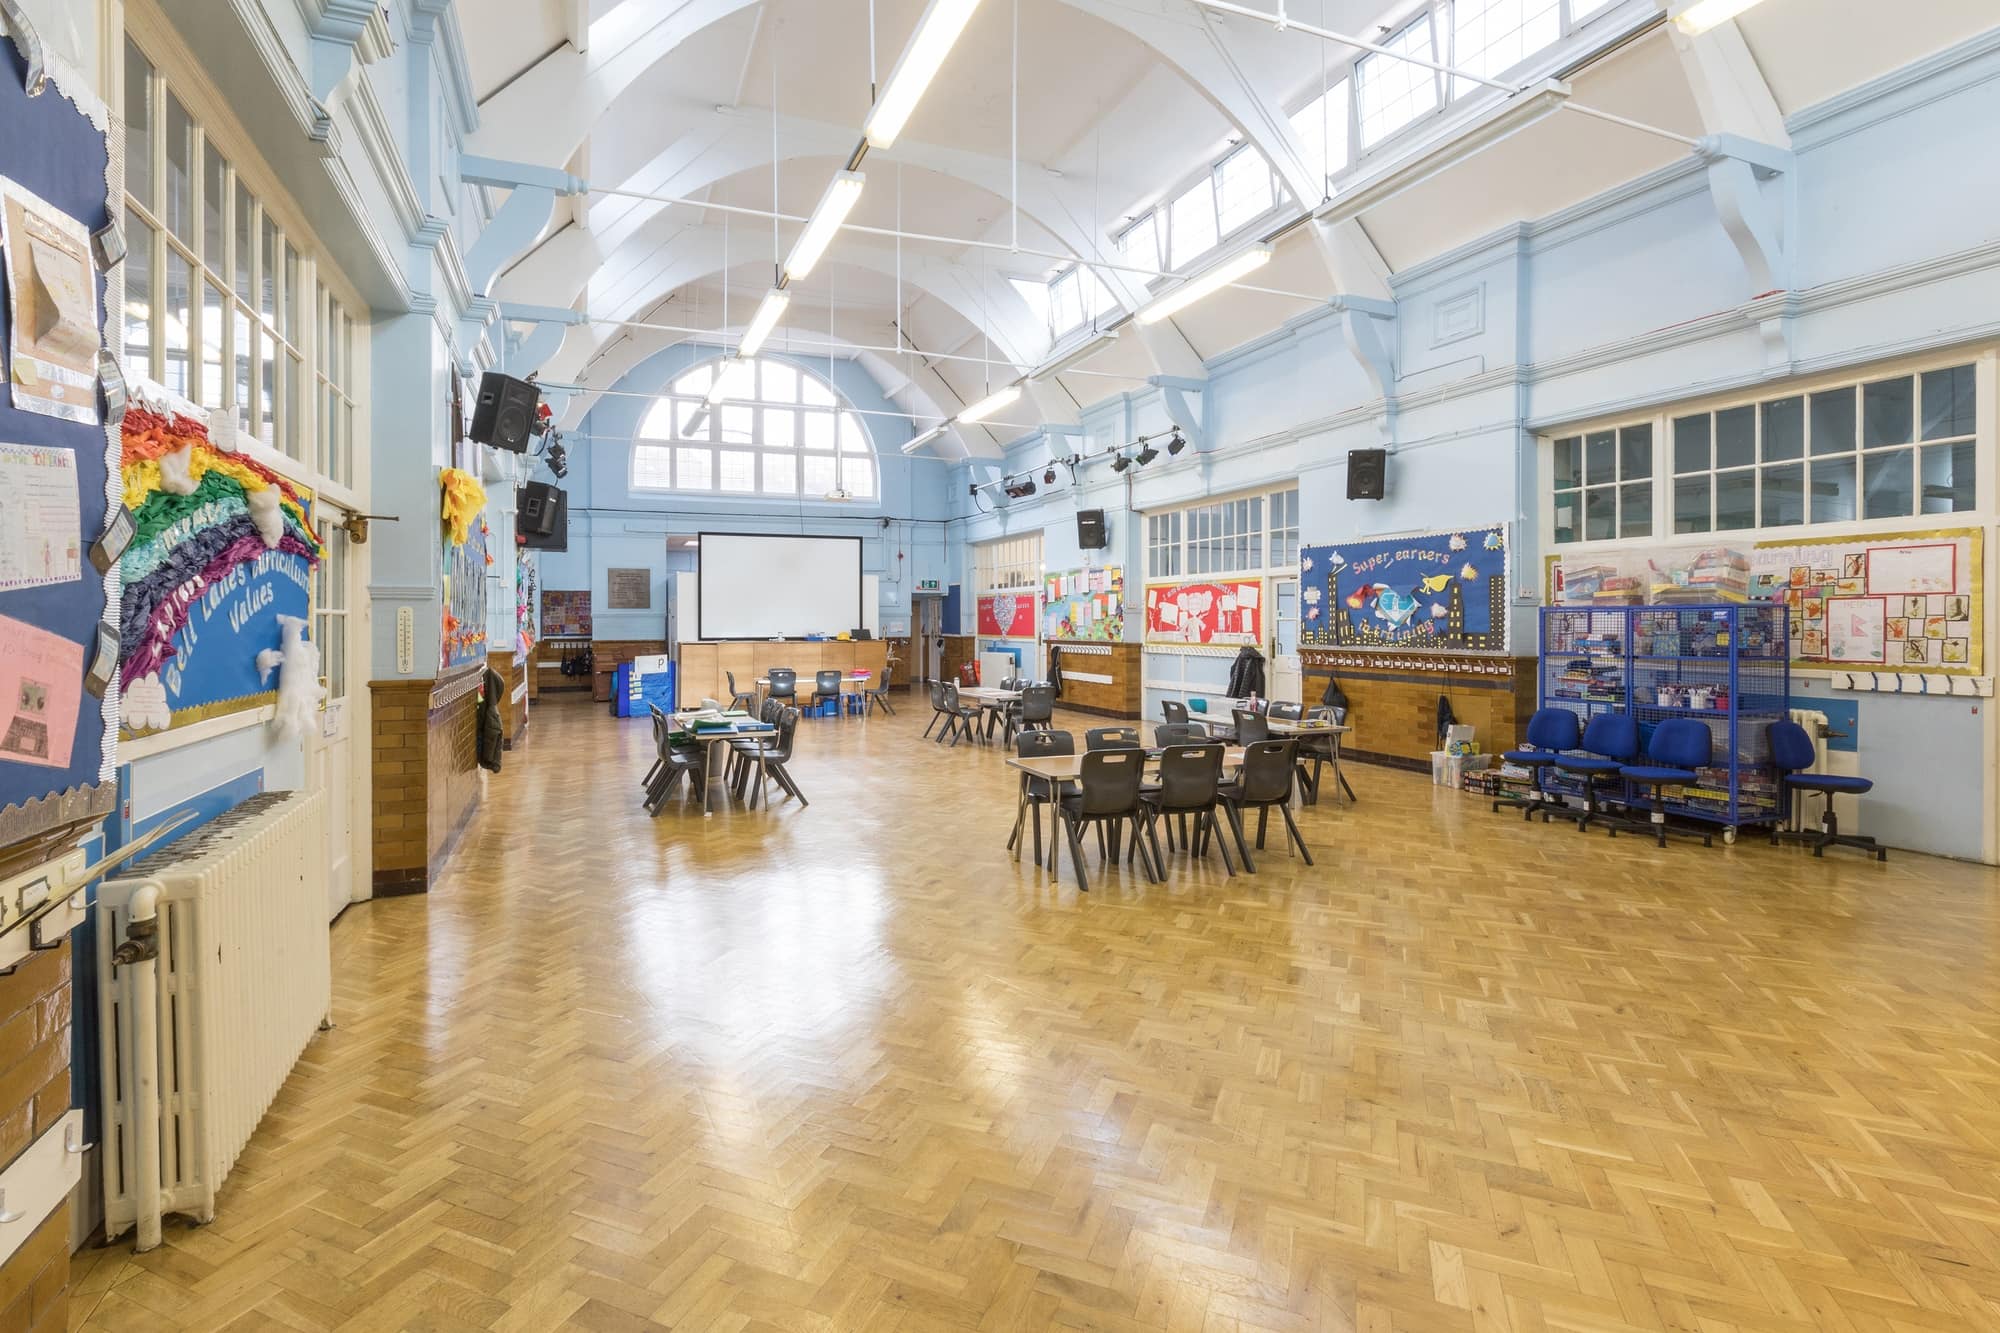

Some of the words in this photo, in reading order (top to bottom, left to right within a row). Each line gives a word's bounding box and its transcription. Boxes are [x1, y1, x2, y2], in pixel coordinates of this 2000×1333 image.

[1352, 552, 1389, 575] Super
[201, 562, 247, 623] Lanes
[229, 581, 274, 633] Values
